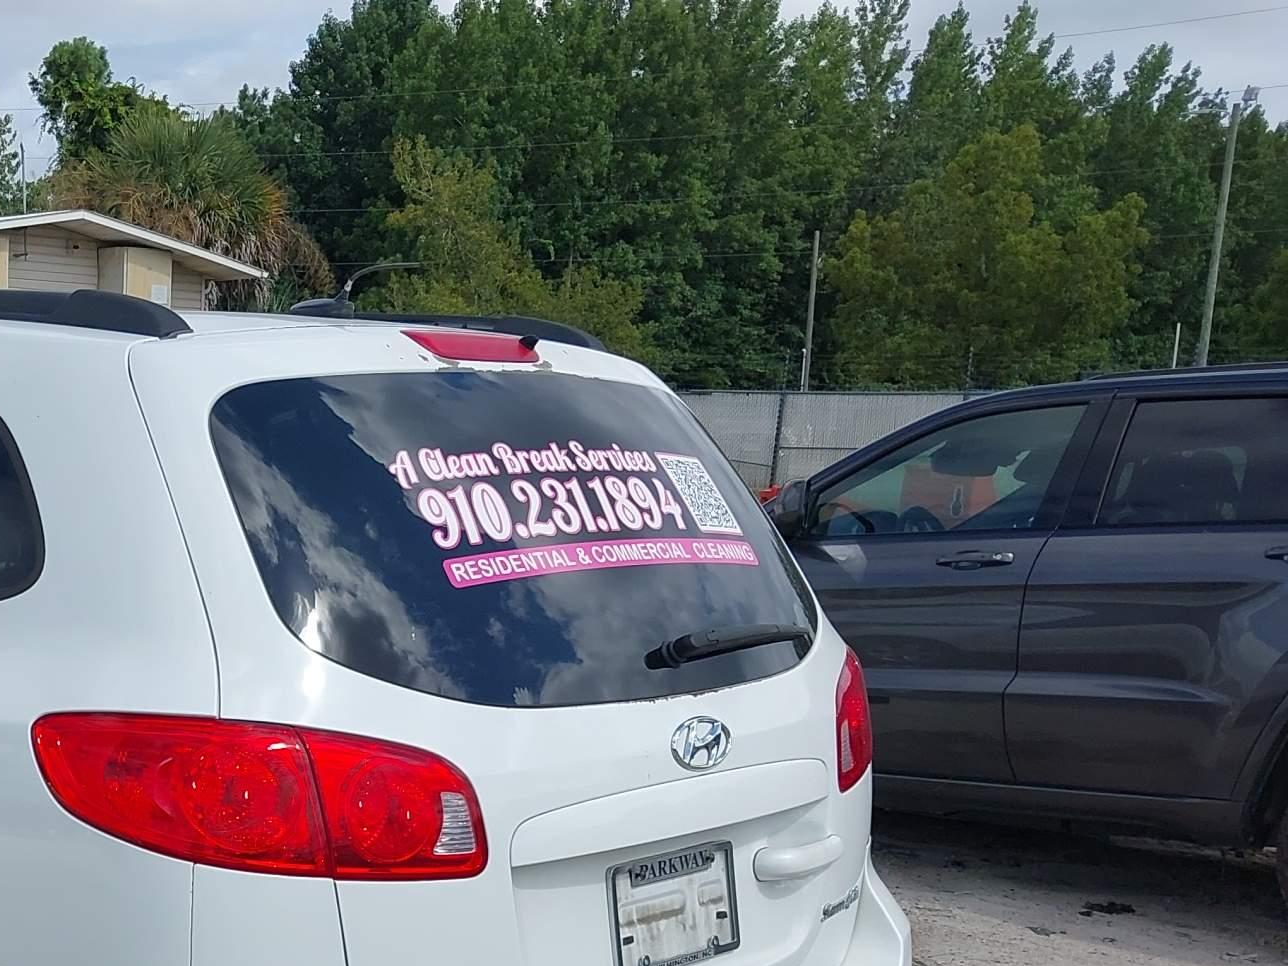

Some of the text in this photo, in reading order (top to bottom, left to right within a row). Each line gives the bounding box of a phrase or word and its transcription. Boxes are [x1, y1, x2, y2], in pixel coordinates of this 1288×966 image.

[388, 439, 657, 489] A Clean Break Services
[416, 475, 688, 551] 910.231.1894
[450, 541, 756, 583] RESIDENTIAL & COMMERCIAL CLEANING
[638, 850, 709, 880] PARKWAY
